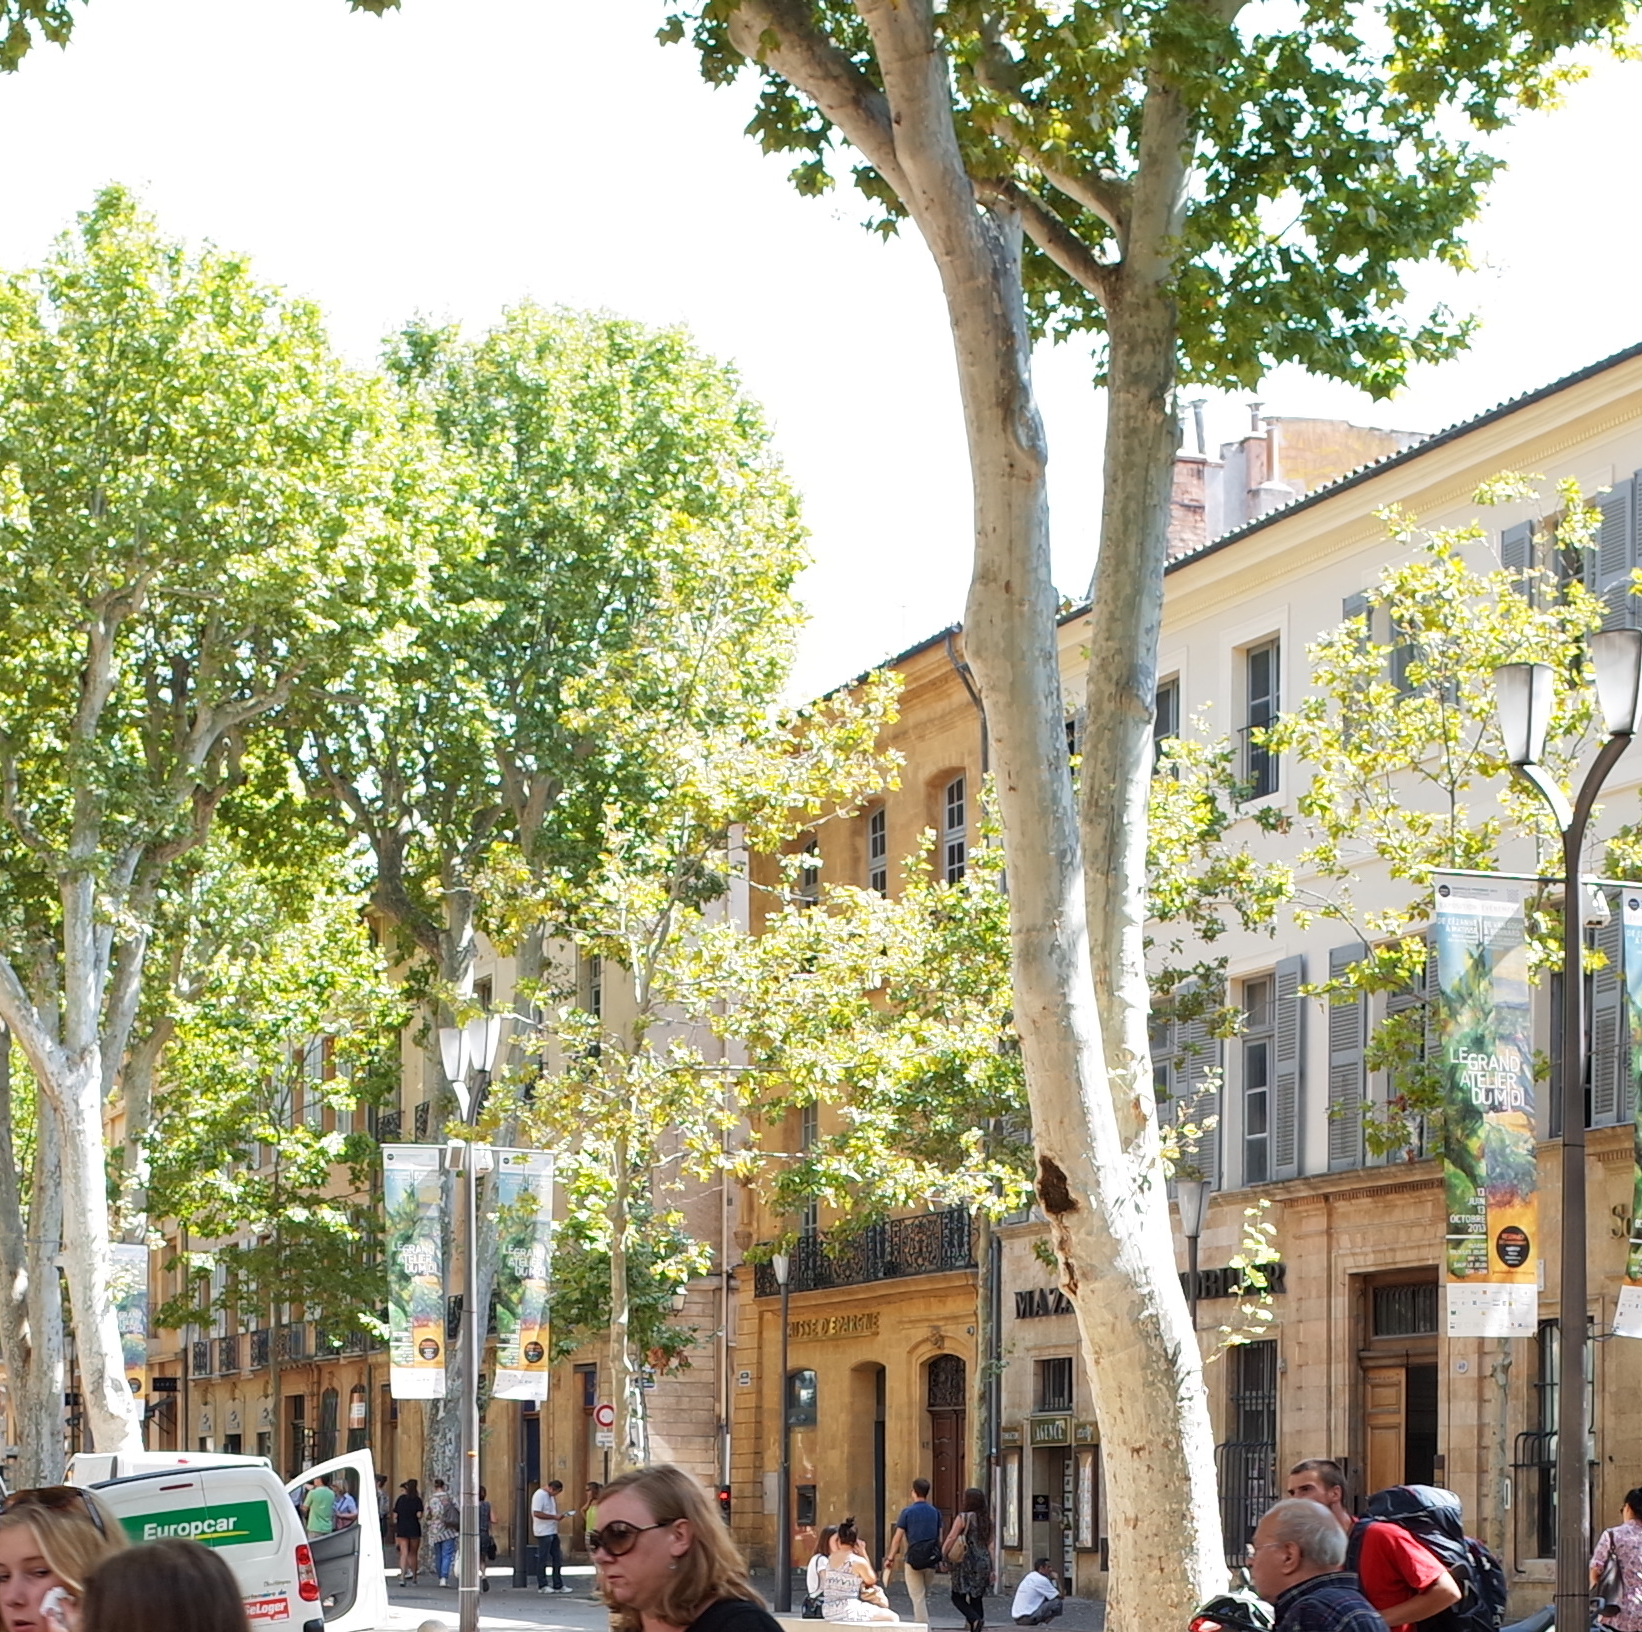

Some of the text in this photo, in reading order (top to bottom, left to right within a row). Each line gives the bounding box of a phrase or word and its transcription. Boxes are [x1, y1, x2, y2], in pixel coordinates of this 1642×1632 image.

[1449, 1046, 1469, 1064] LE
[1467, 1049, 1521, 1072] GRAND
[1459, 1069, 1517, 1089] ATELIER
[1471, 1086, 1526, 1111] DU MIDI
[1468, 1197, 1486, 1206] JUIN
[1449, 1214, 1486, 1224] OCTOBRE
[1467, 1223, 1486, 1233] 2013
[392, 1241, 403, 1251] LE
[503, 1244, 514, 1254] LE
[788, 1312, 880, 1338] AISSE D'EPARGNE
[1036, 1423, 1064, 1442] AGENCE
[143, 1516, 238, 1541] Europcar
